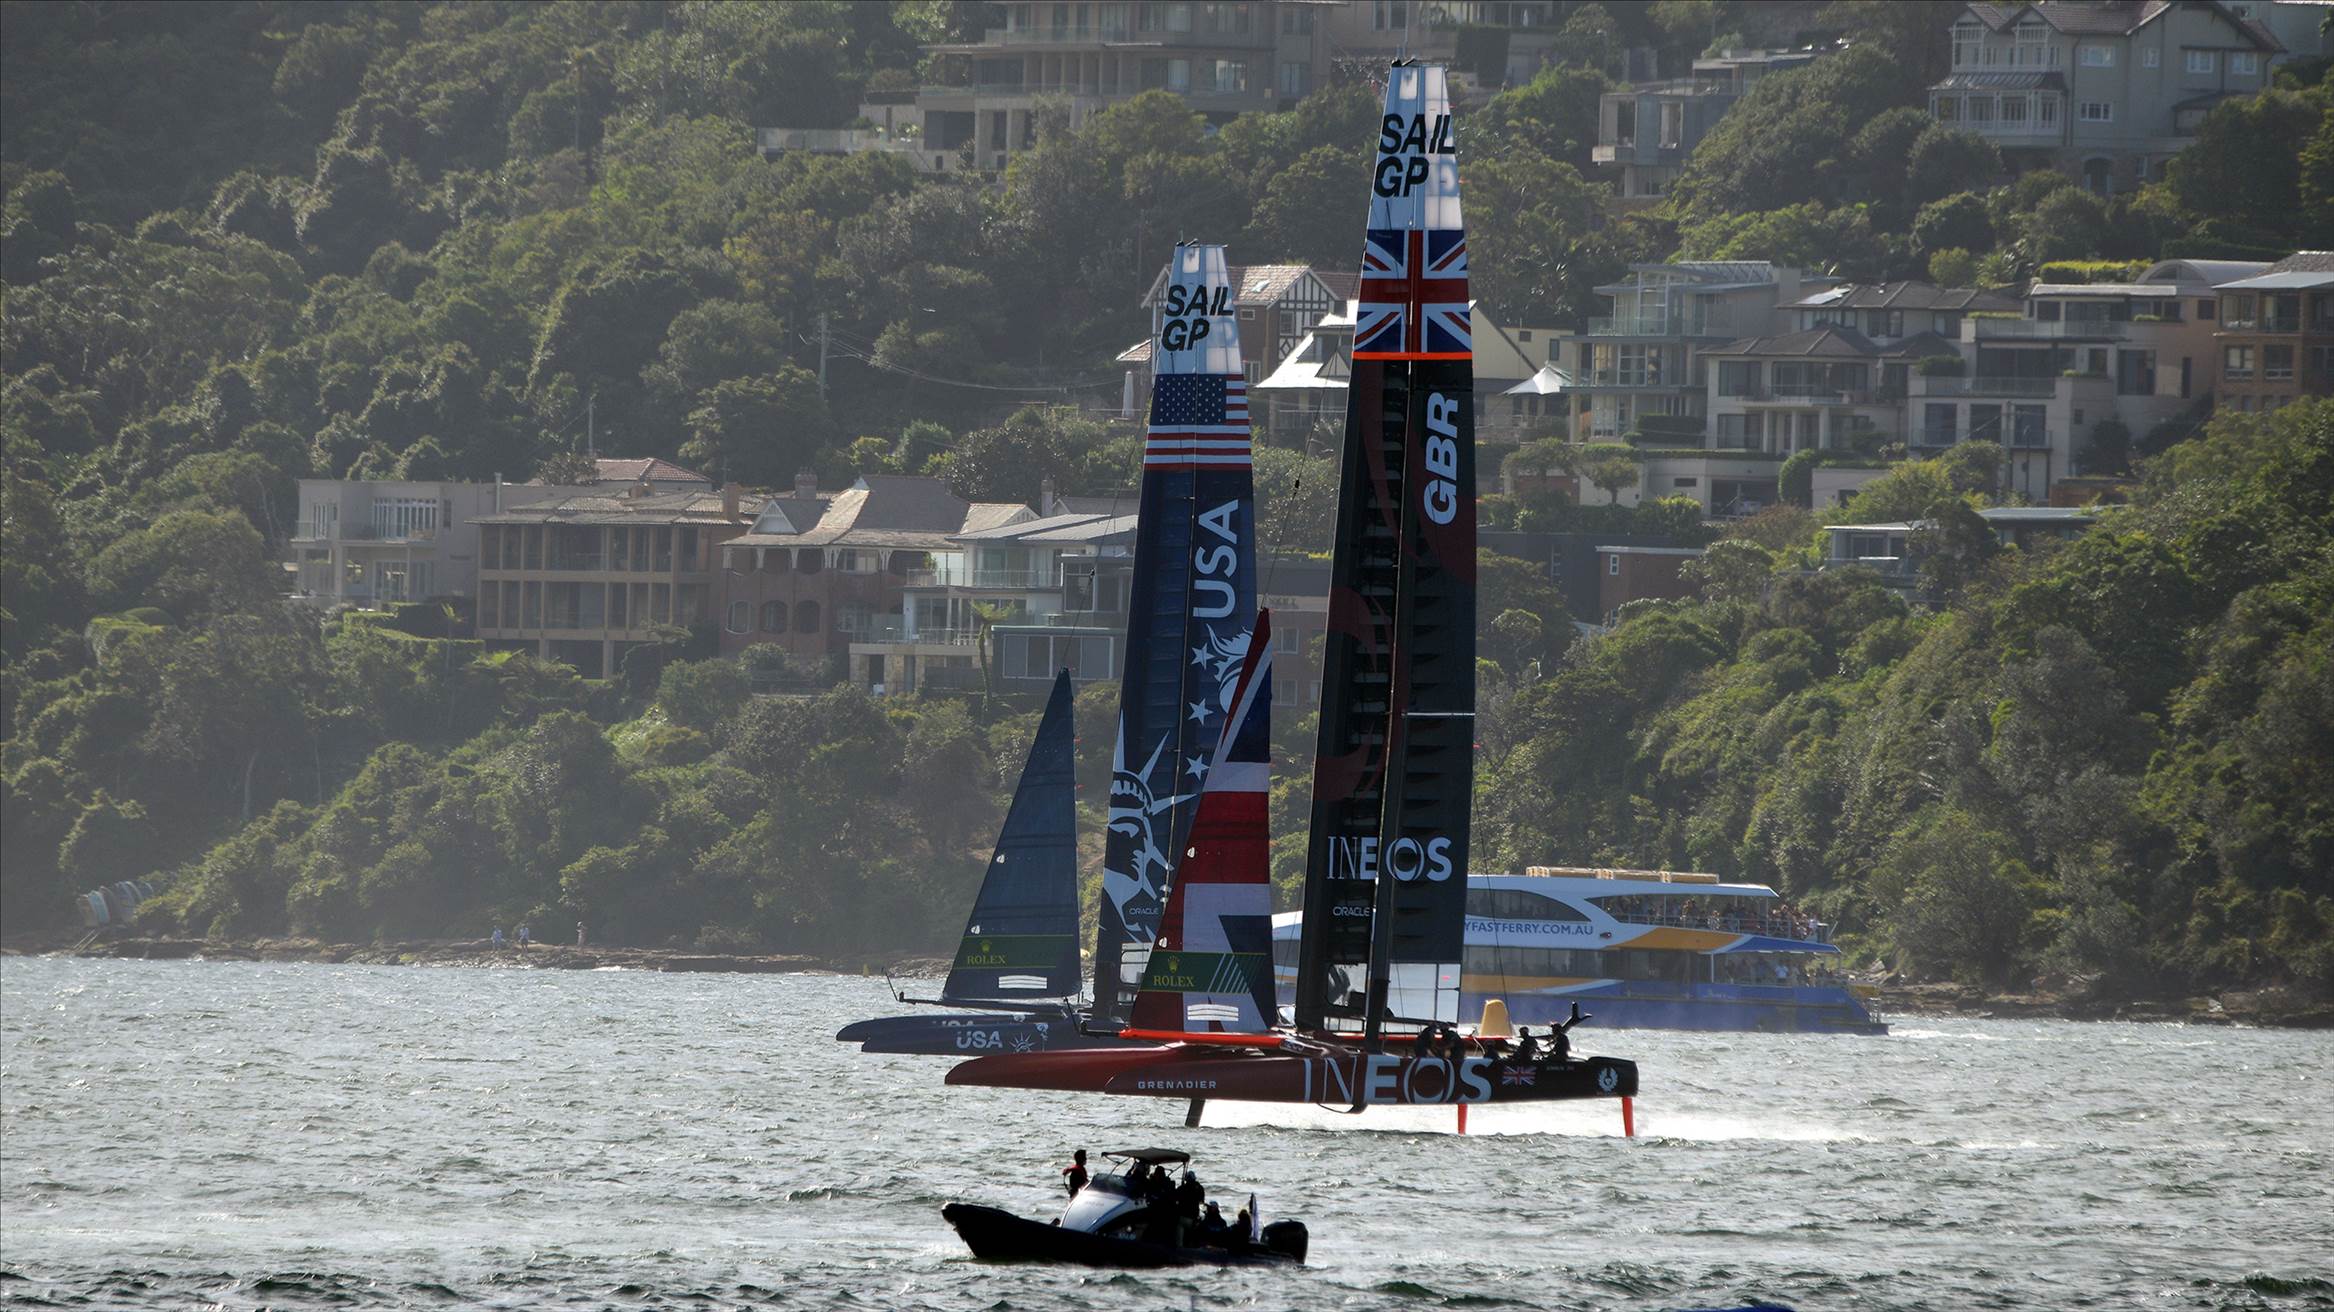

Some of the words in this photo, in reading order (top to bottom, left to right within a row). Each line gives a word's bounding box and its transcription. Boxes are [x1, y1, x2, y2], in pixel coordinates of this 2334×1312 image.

[1379, 113, 1455, 154] SAIL
[1374, 156, 1429, 198] GP
[1165, 285, 1234, 317] SAIL
[1161, 318, 1210, 351] GP
[1424, 392, 1458, 525] GBR
[1193, 499, 1239, 618] USA
[1326, 836, 1453, 882] INEOS
[1129, 907, 1159, 915] ORACLE
[1332, 906, 1371, 917] ORACLE
[967, 954, 1007, 965] ROLEX
[1153, 975, 1195, 987] ROLEX
[956, 1030, 1003, 1049] USA
[1138, 1080, 1217, 1089] GRENADIER
[1304, 1054, 1494, 1104] INEOS
